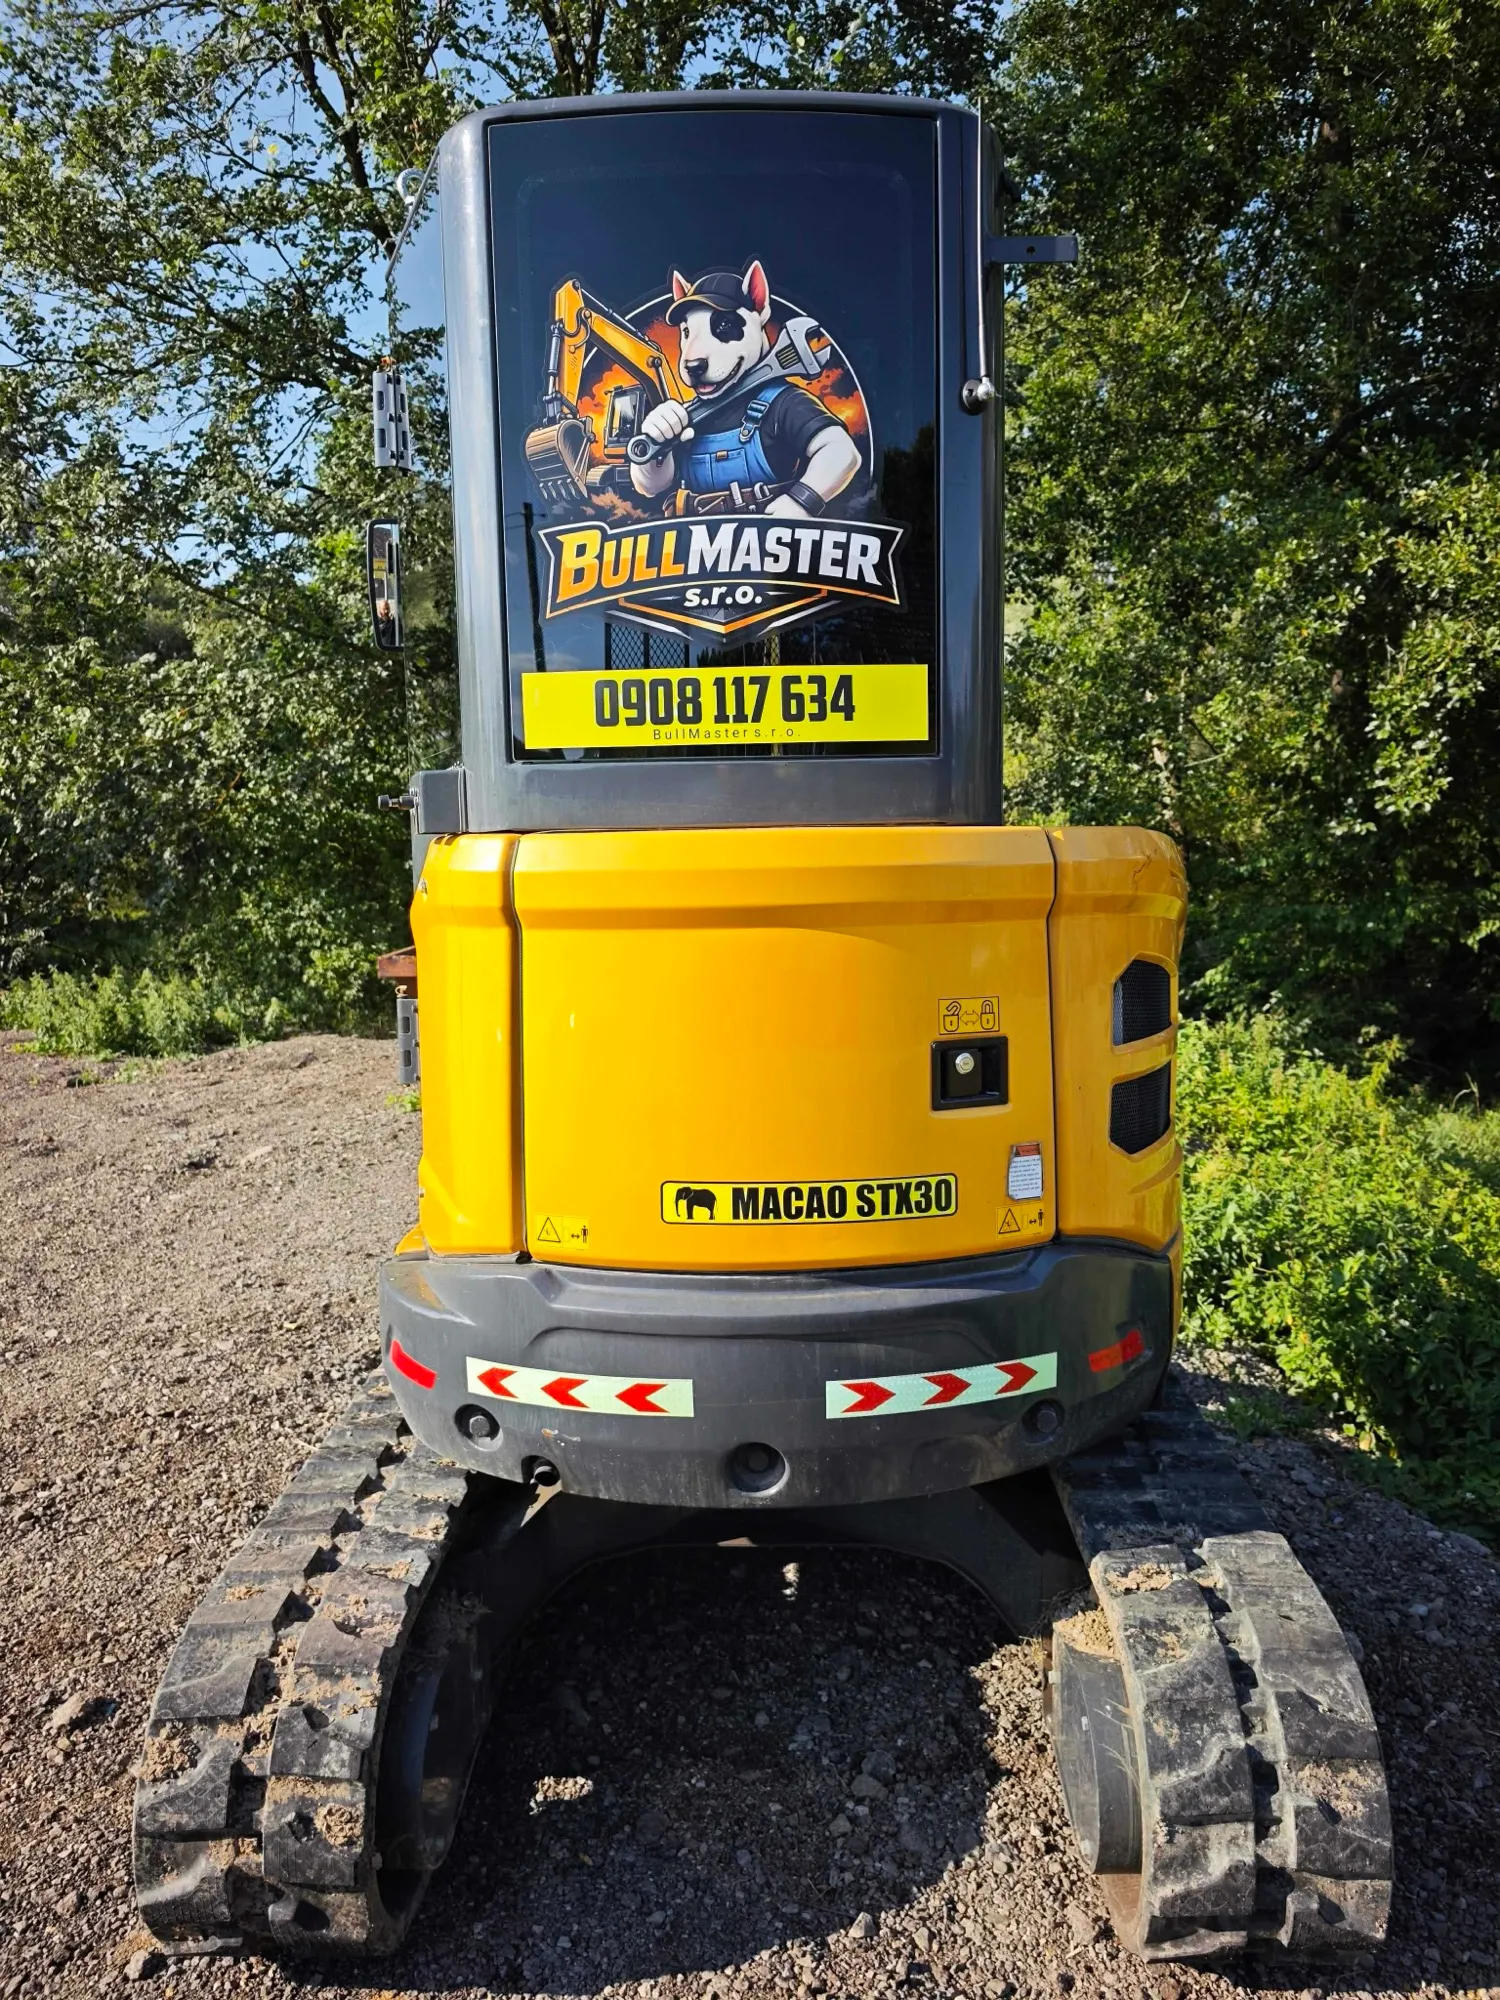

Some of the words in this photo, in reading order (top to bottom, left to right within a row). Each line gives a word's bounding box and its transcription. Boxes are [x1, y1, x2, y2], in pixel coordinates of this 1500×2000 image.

[684, 584, 763, 607] s.r.o.
[595, 678, 702, 727] 0908
[713, 676, 770, 724] 117
[781, 674, 855, 722] 634
[653, 727, 747, 741] BullMaster
[755, 727, 801, 740] s.r.o.
[731, 1185, 847, 1220] MACAO
[855, 1178, 952, 1218] STX30
